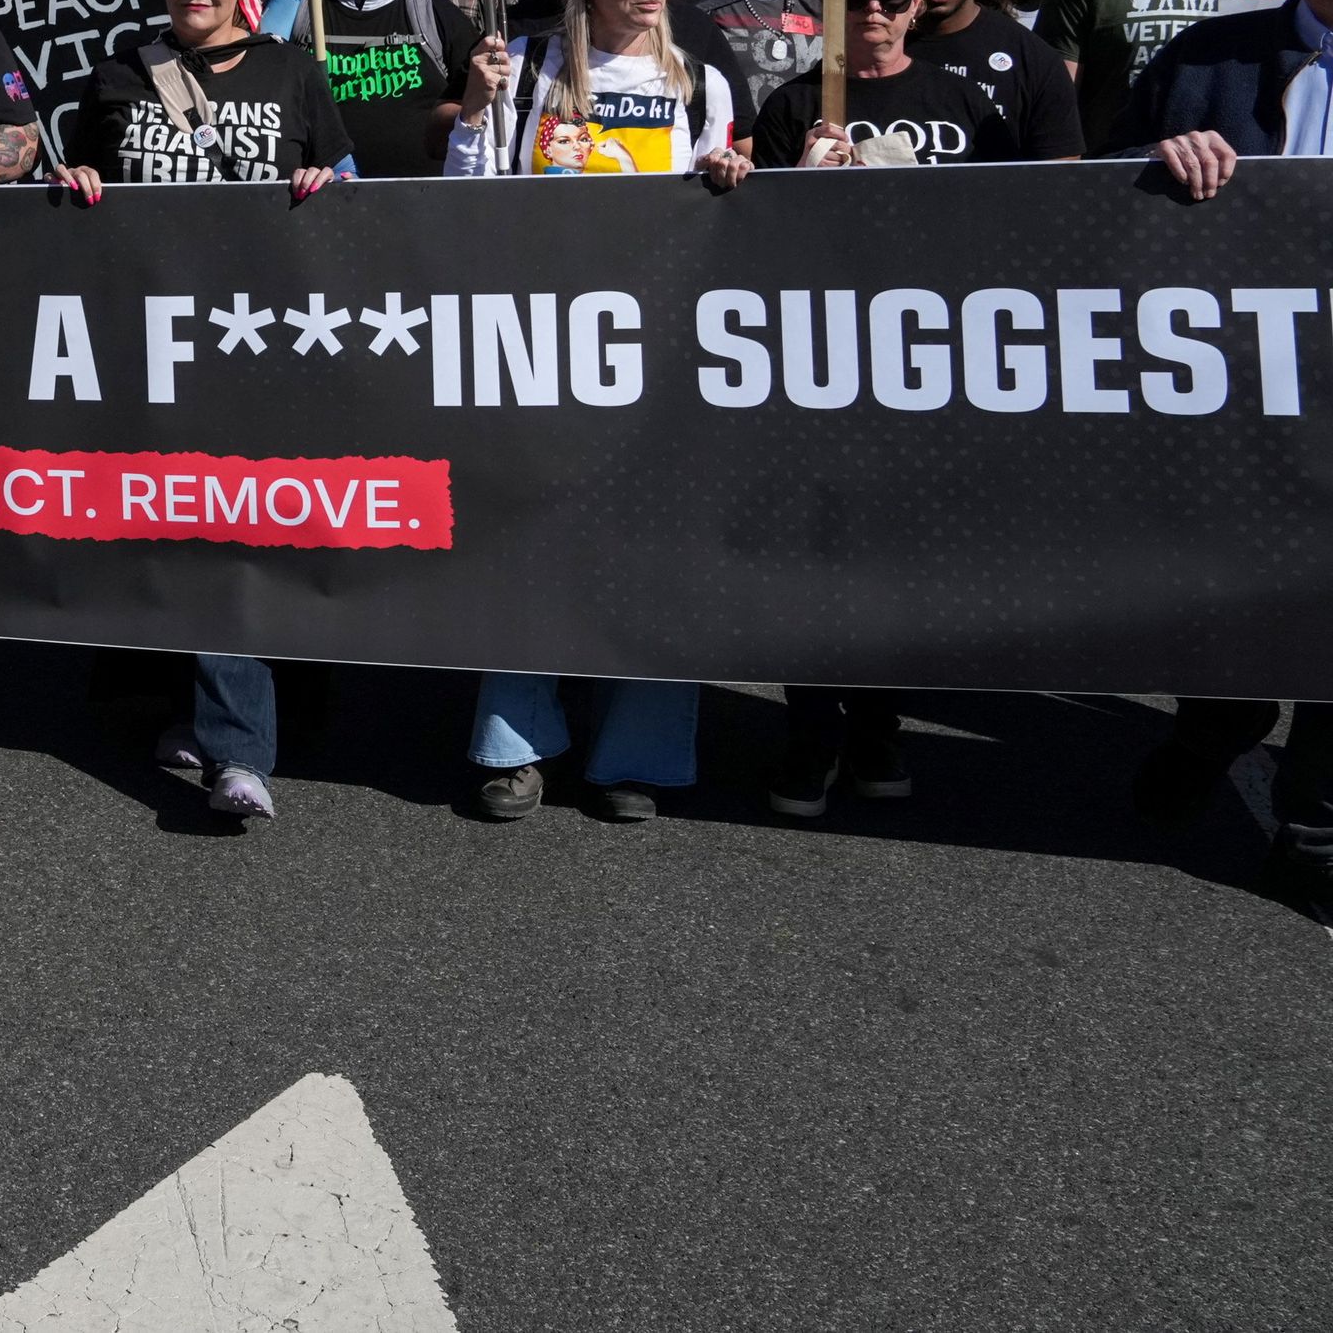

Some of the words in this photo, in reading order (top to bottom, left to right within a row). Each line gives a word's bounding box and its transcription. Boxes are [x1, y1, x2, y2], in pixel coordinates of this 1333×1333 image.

[130, 100, 282, 130] VERANS
[619, 96, 645, 118] Do
[649, 98, 670, 119] It!
[844, 119, 968, 154] OOD
[28, 295, 103, 401] A
[695, 287, 1333, 416] SUGGEST
[121, 473, 422, 529] REMOVE.
